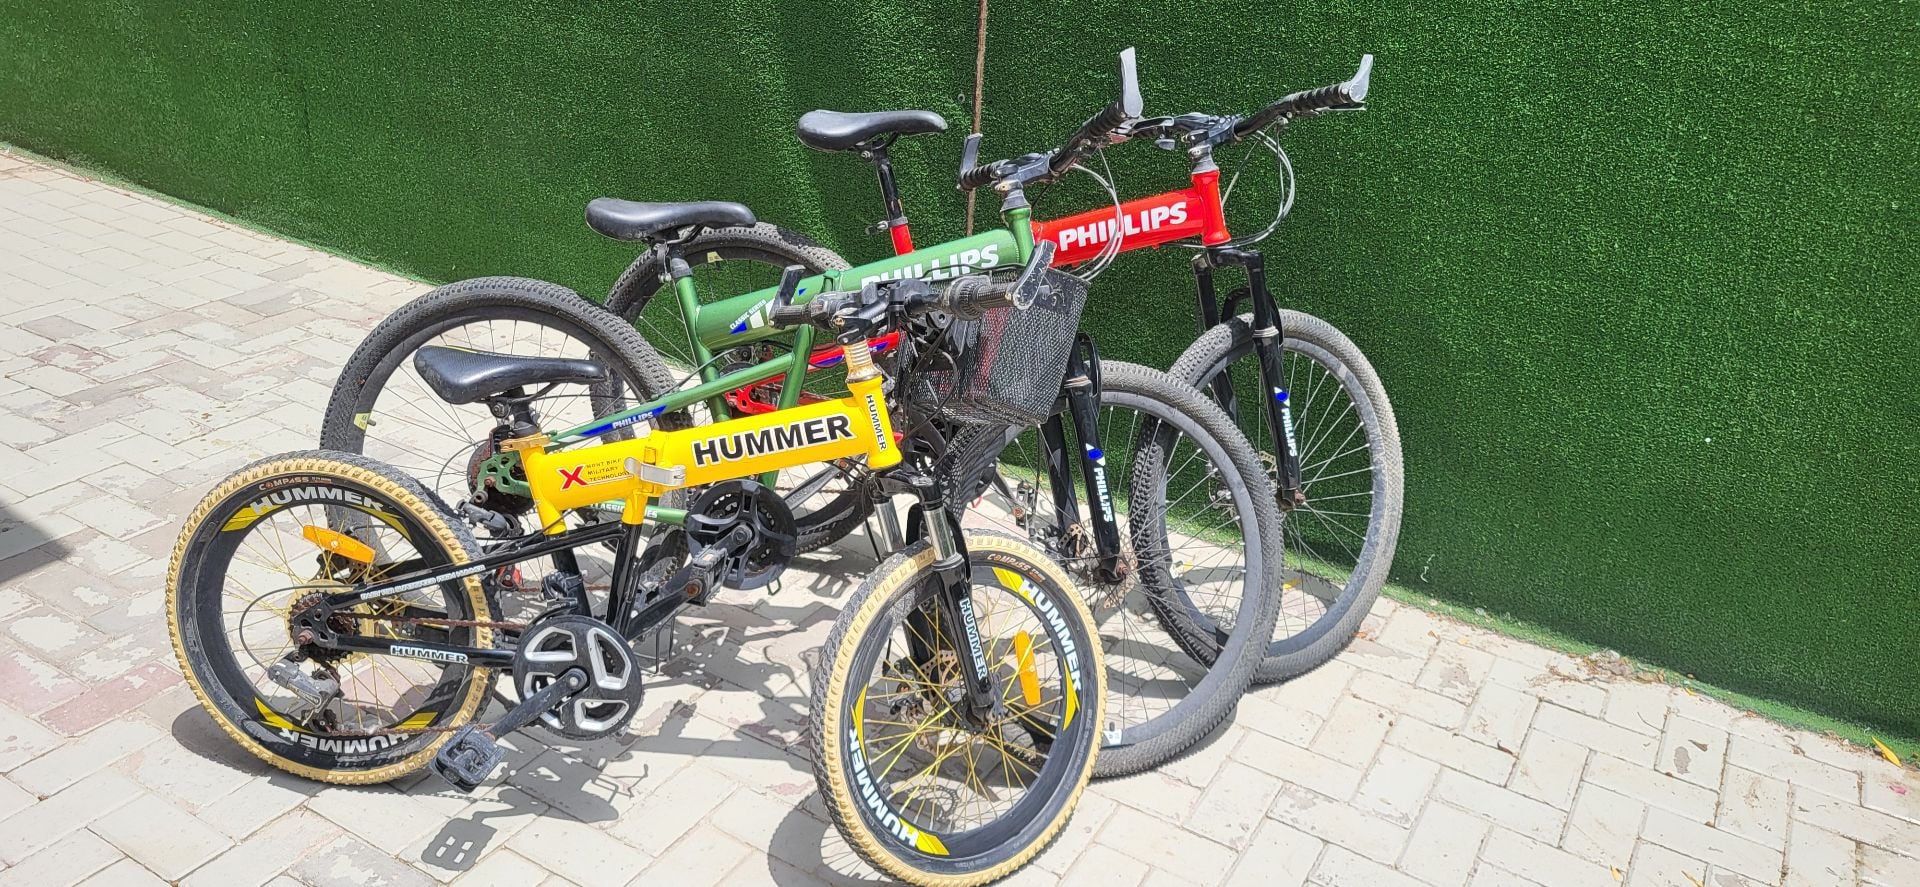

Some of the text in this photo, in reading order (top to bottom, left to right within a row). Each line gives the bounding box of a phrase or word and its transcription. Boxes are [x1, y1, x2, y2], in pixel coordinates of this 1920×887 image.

[1059, 202, 1188, 251] PHILLIPS
[729, 311, 750, 330] CLASSIC
[612, 411, 654, 429] PHILLIPS
[866, 394, 887, 451] HUMMER
[1281, 407, 1298, 457] PHILLIPS
[692, 413, 856, 467] HUMMER
[259, 476, 310, 491] COMPASS
[558, 465, 588, 490] X
[587, 466, 619, 475] MILITARY
[250, 486, 385, 515] HUMMER
[1094, 467, 1114, 522] PHILLIPS
[987, 553, 1031, 571] COMPASS
[959, 597, 988, 681] HUMMER
[1019, 578, 1082, 692] HUMMER
[390, 645, 470, 664] HUMMER
[279, 727, 410, 754] HUMMER
[849, 728, 919, 848] HUMMER
